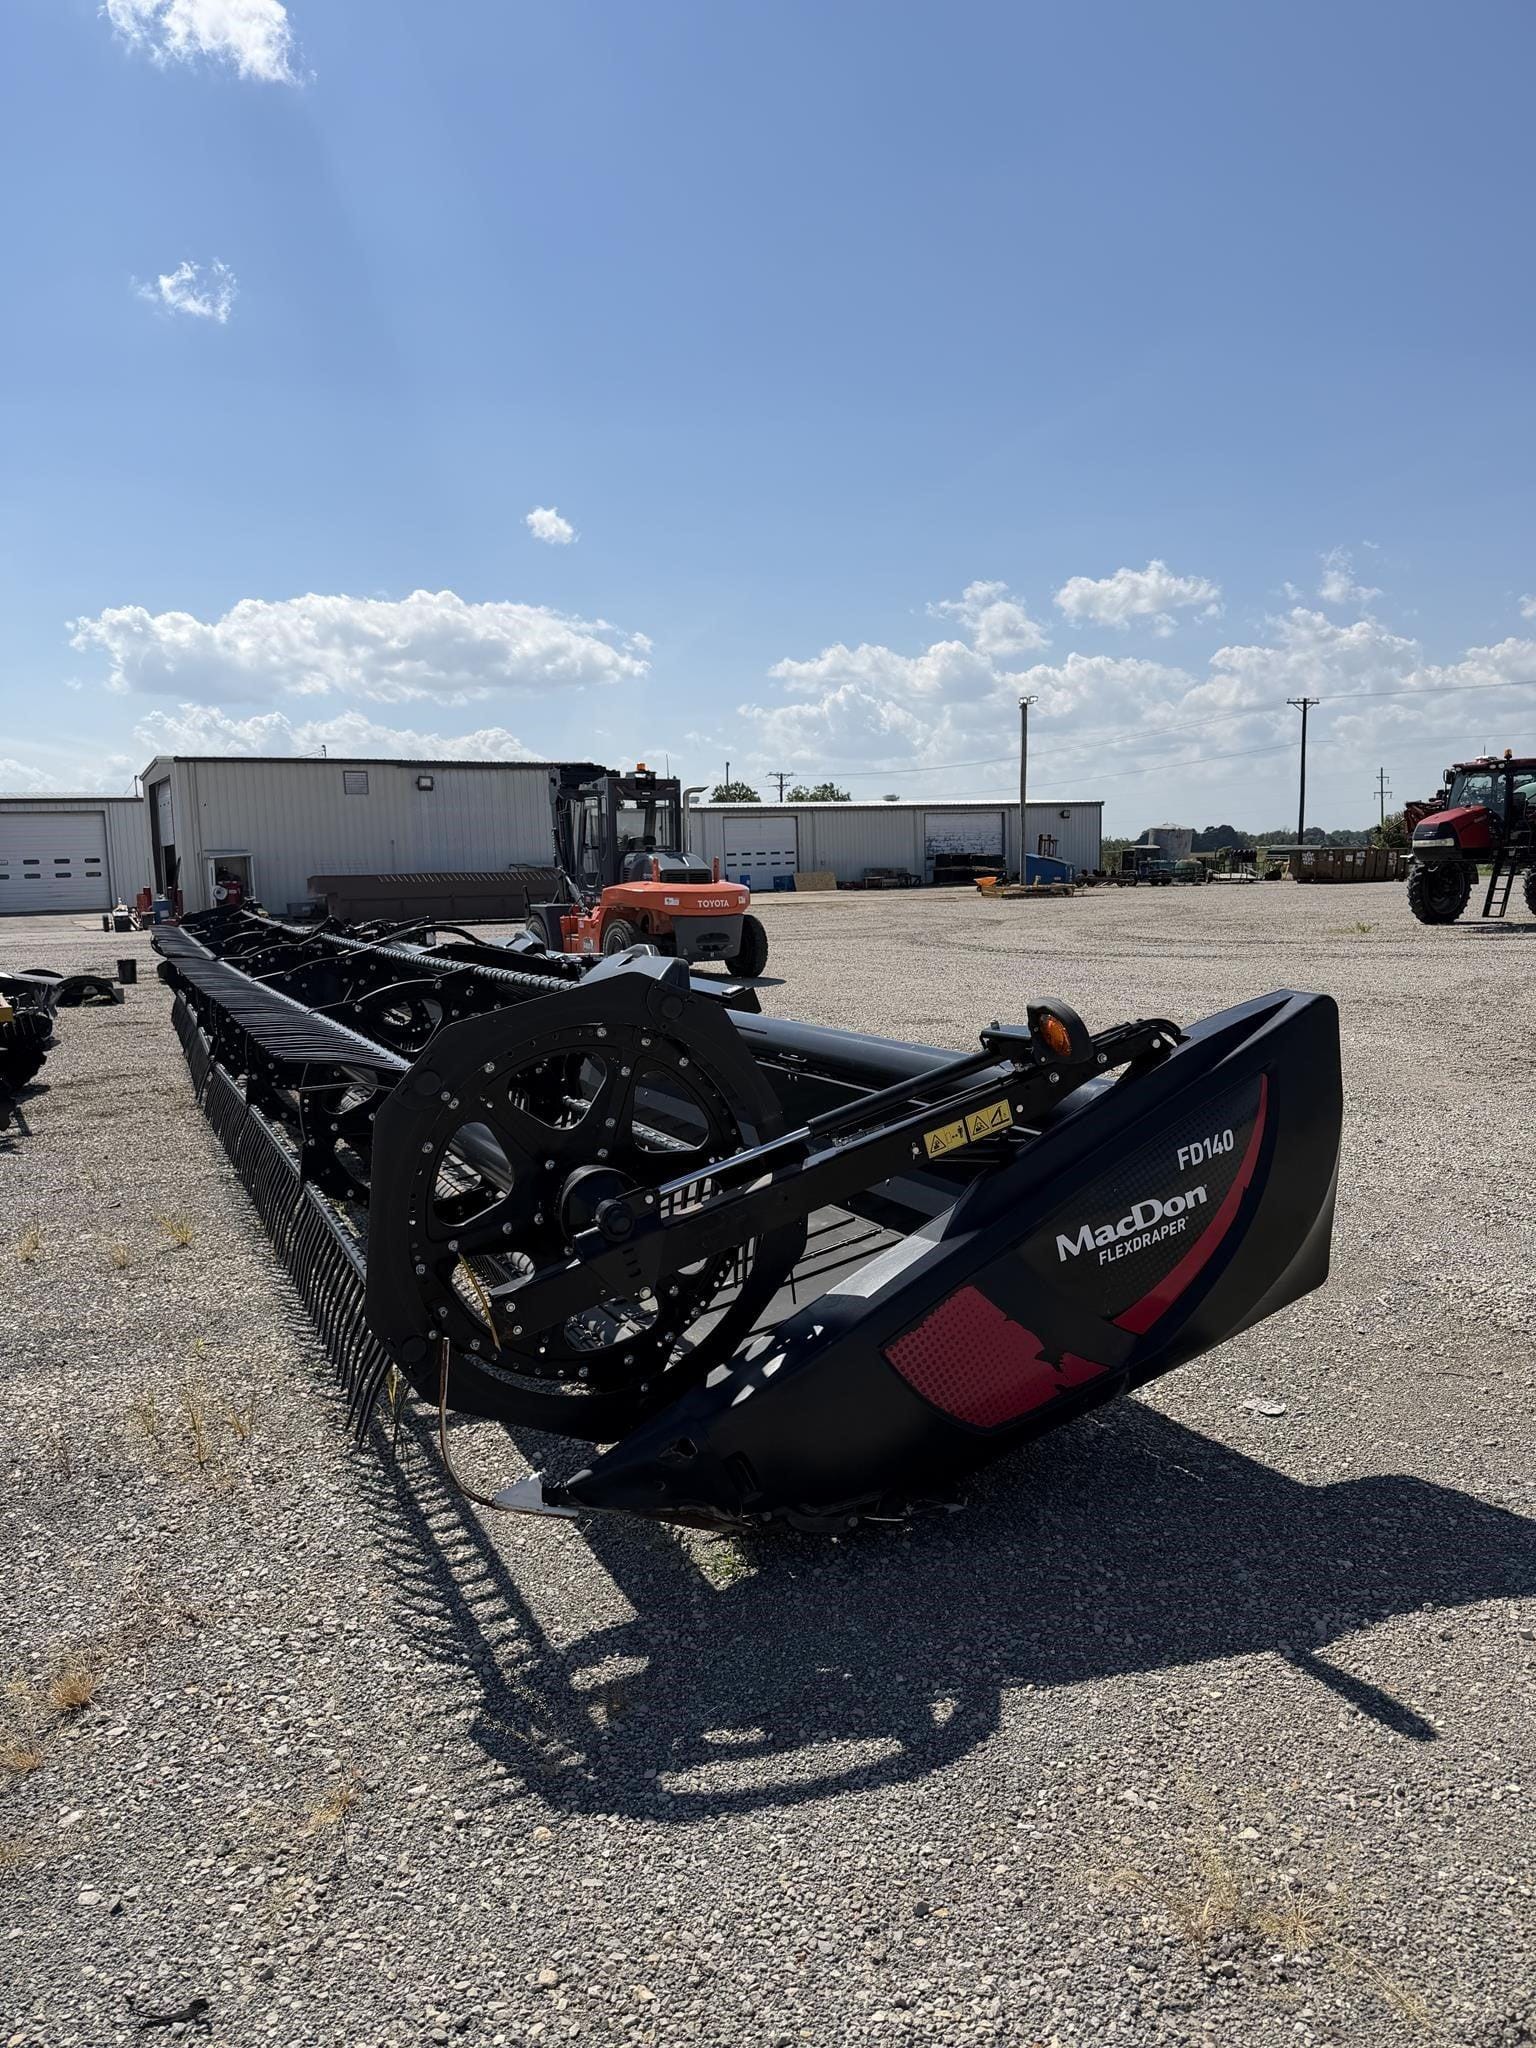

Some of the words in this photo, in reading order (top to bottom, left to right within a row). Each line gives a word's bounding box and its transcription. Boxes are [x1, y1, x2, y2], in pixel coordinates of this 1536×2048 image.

[697, 899, 729, 908] TOYOTA
[1176, 1128, 1235, 1171] FD140
[1055, 1184, 1208, 1262] MacDon
[1098, 1218, 1187, 1266] FLEXDRAPER
